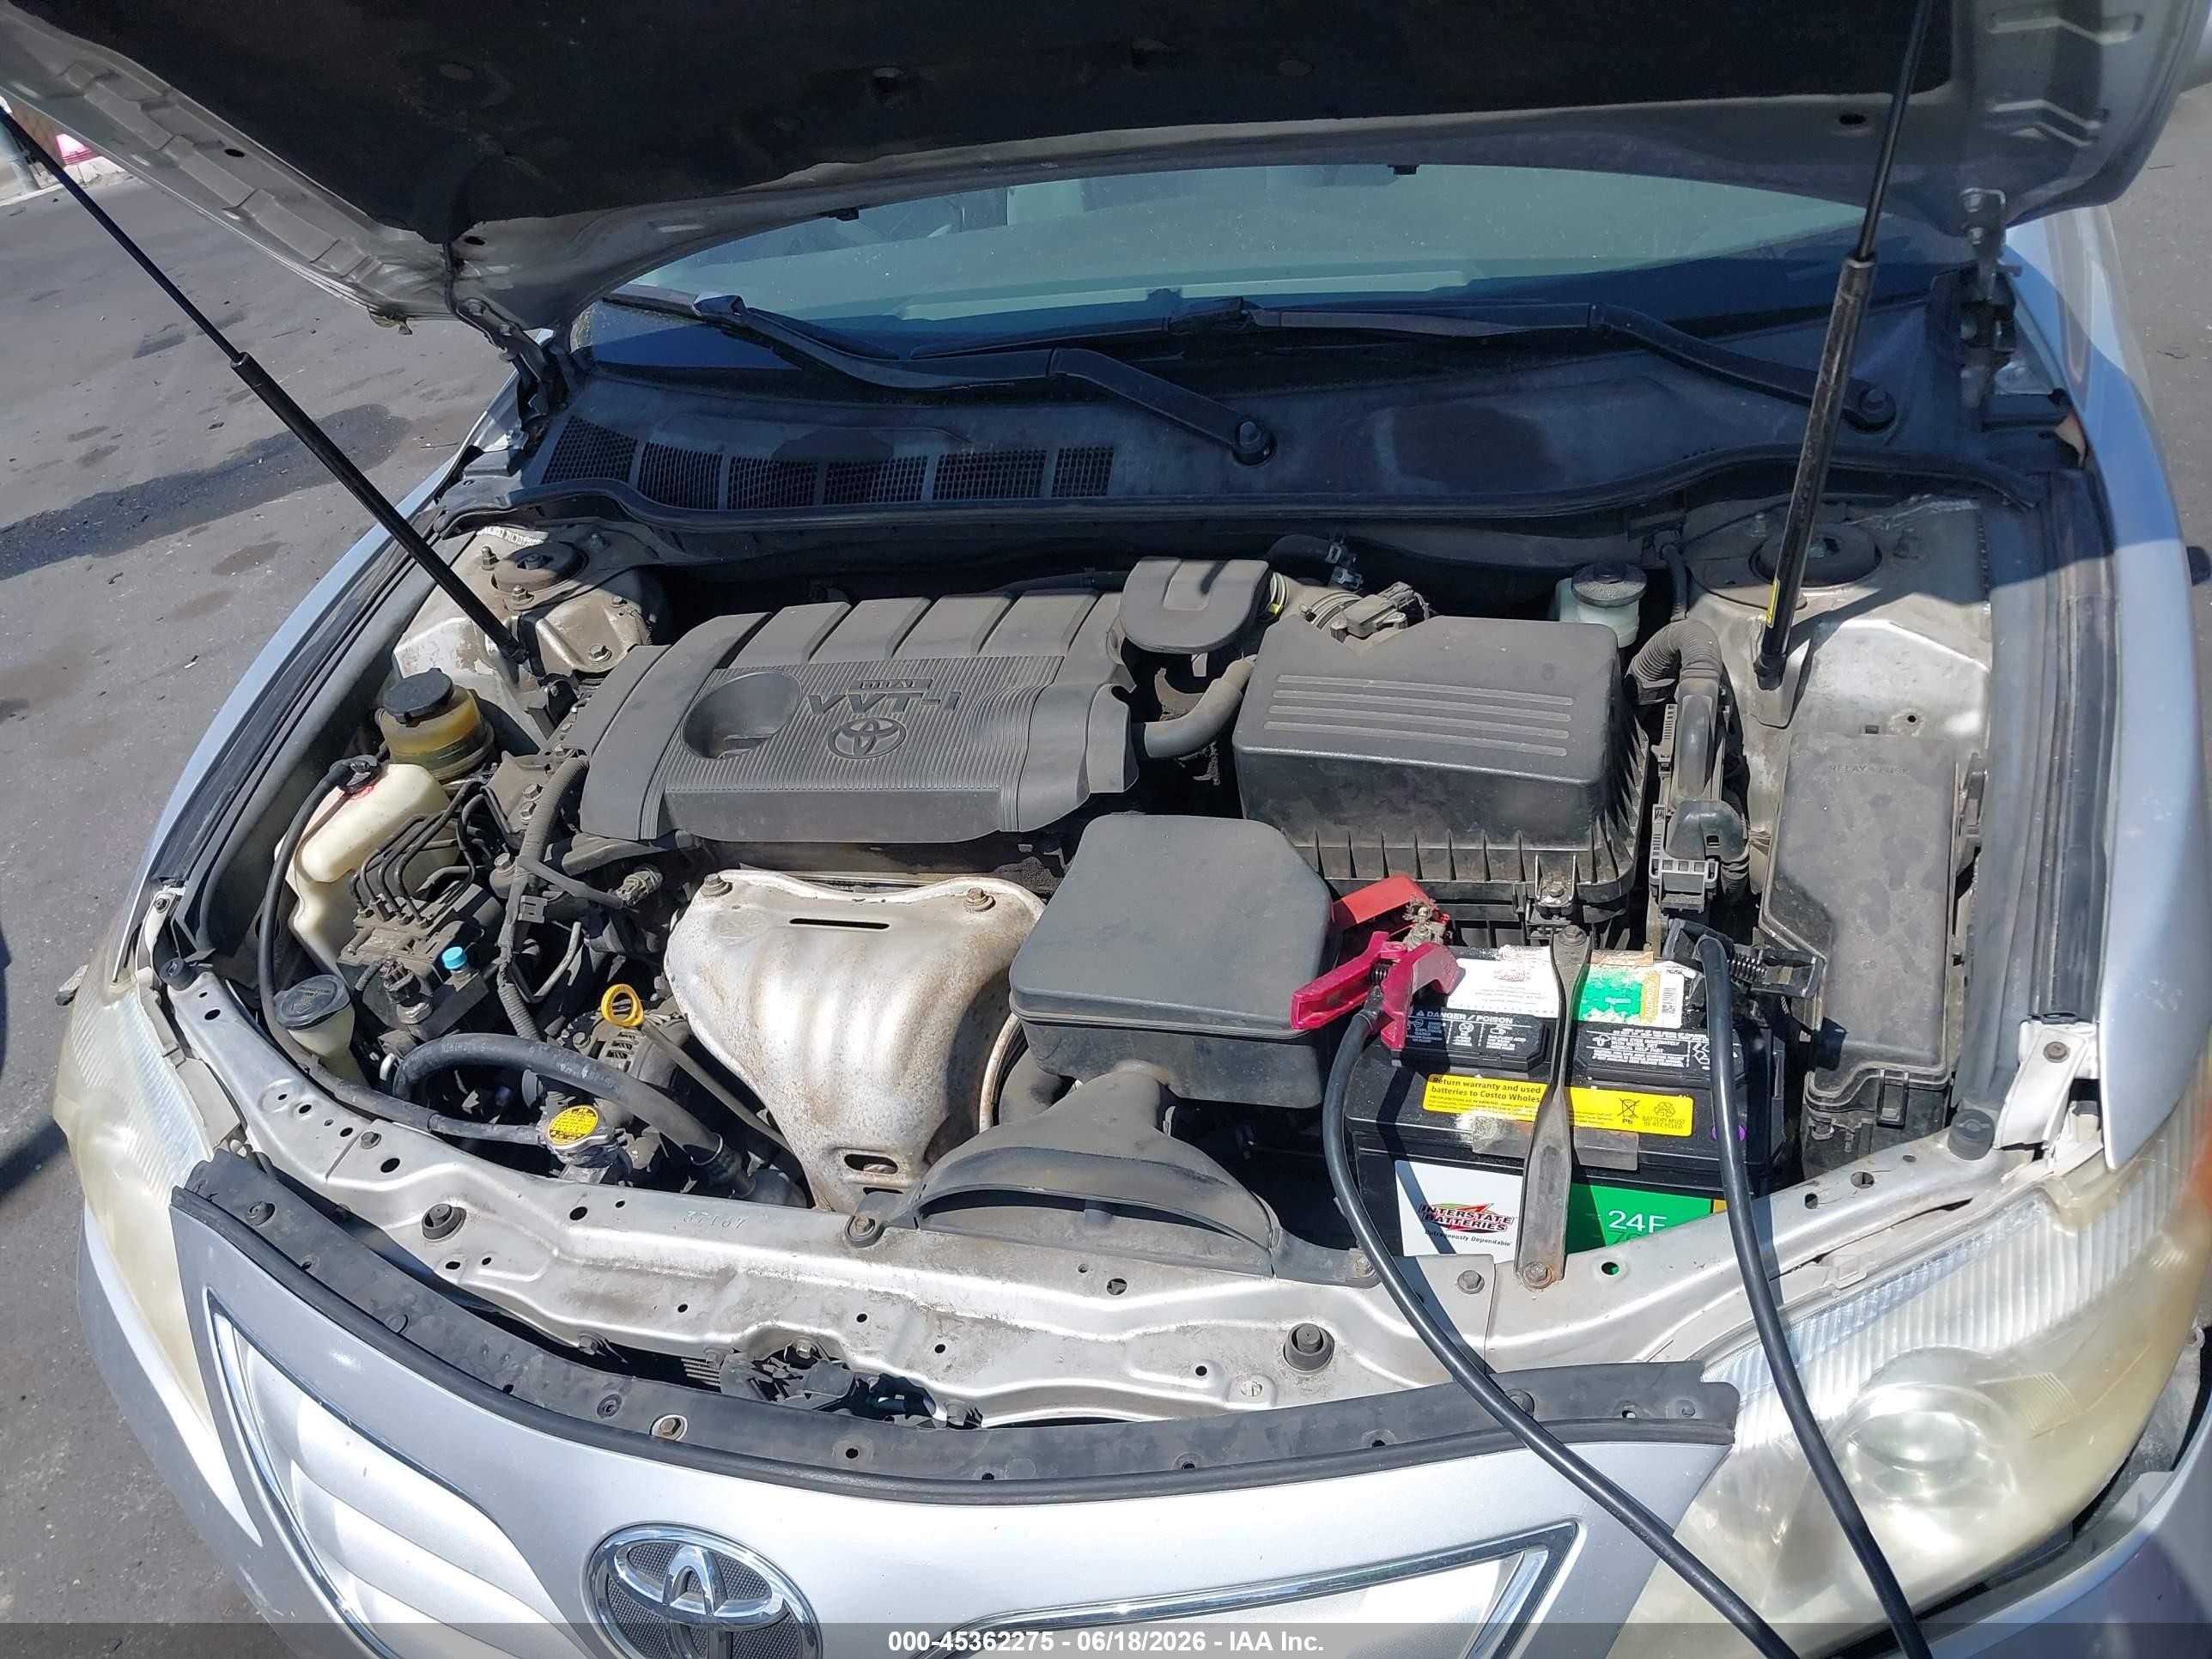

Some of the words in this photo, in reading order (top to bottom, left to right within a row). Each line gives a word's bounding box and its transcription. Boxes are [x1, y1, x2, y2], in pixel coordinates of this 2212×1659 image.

[1426, 1011, 1467, 1020] DANGER
[1476, 1015, 1513, 1024] POISON
[1431, 1086, 1468, 1097] batteries
[1469, 1089, 1479, 1097] to
[1480, 1091, 1507, 1100] Costco
[1432, 1077, 1461, 1086] Return
[1462, 1080, 1500, 1091] warranty
[1502, 1083, 1519, 1091] and
[1520, 1085, 1541, 1094] used
[1419, 1204, 1513, 1225] INTERSTATE
[1422, 1212, 1507, 1231] BATTERIES
[1425, 1230, 1468, 1242] Outrageously
[1471, 1236, 1511, 1247] Dependable
